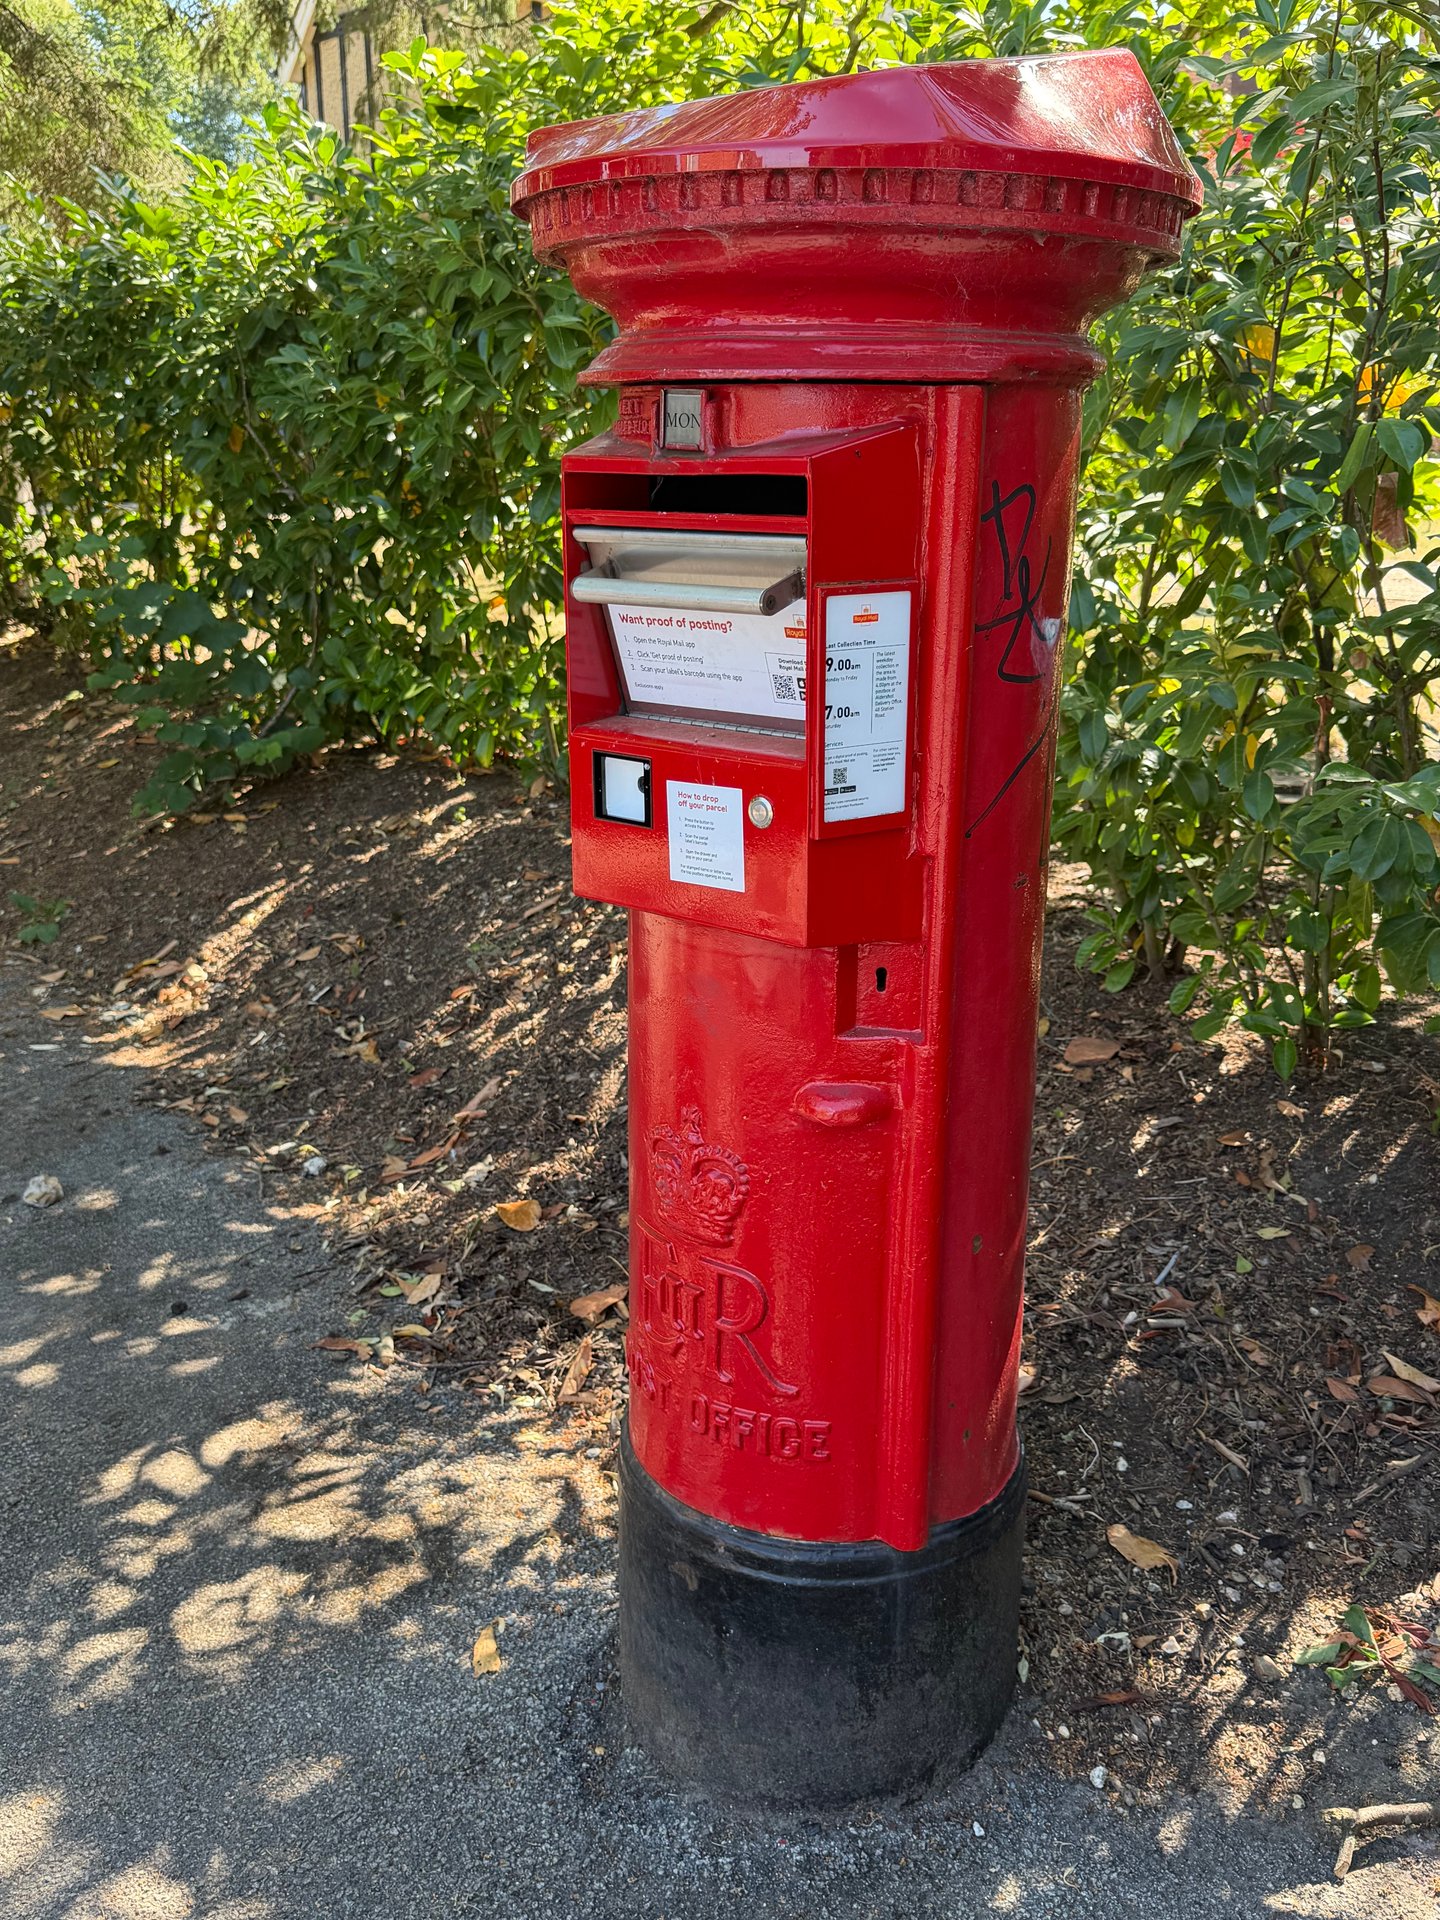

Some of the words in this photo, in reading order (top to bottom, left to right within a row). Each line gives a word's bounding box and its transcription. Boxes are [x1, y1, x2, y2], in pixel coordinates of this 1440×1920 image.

[666, 412, 701, 428] MON
[618, 613, 644, 625] Want
[646, 616, 673, 627] proof
[676, 617, 686, 628] of
[689, 619, 733, 634] posting?
[785, 629, 804, 637] Royal
[633, 636, 647, 644] Open
[657, 638, 672, 647] Royal
[685, 641, 695, 649] app
[837, 640, 862, 648] Collection
[637, 650, 649, 658] Click
[661, 653, 676, 661] proof
[778, 658, 803, 666] Download
[666, 667, 683, 675] label's
[683, 669, 705, 678] barcode
[706, 672, 721, 680] using
[722, 672, 731, 680] the
[677, 791, 692, 799] How
[702, 794, 719, 803] drop
[706, 804, 728, 812] parcel
[690, 1393, 833, 1464] OFFICE
